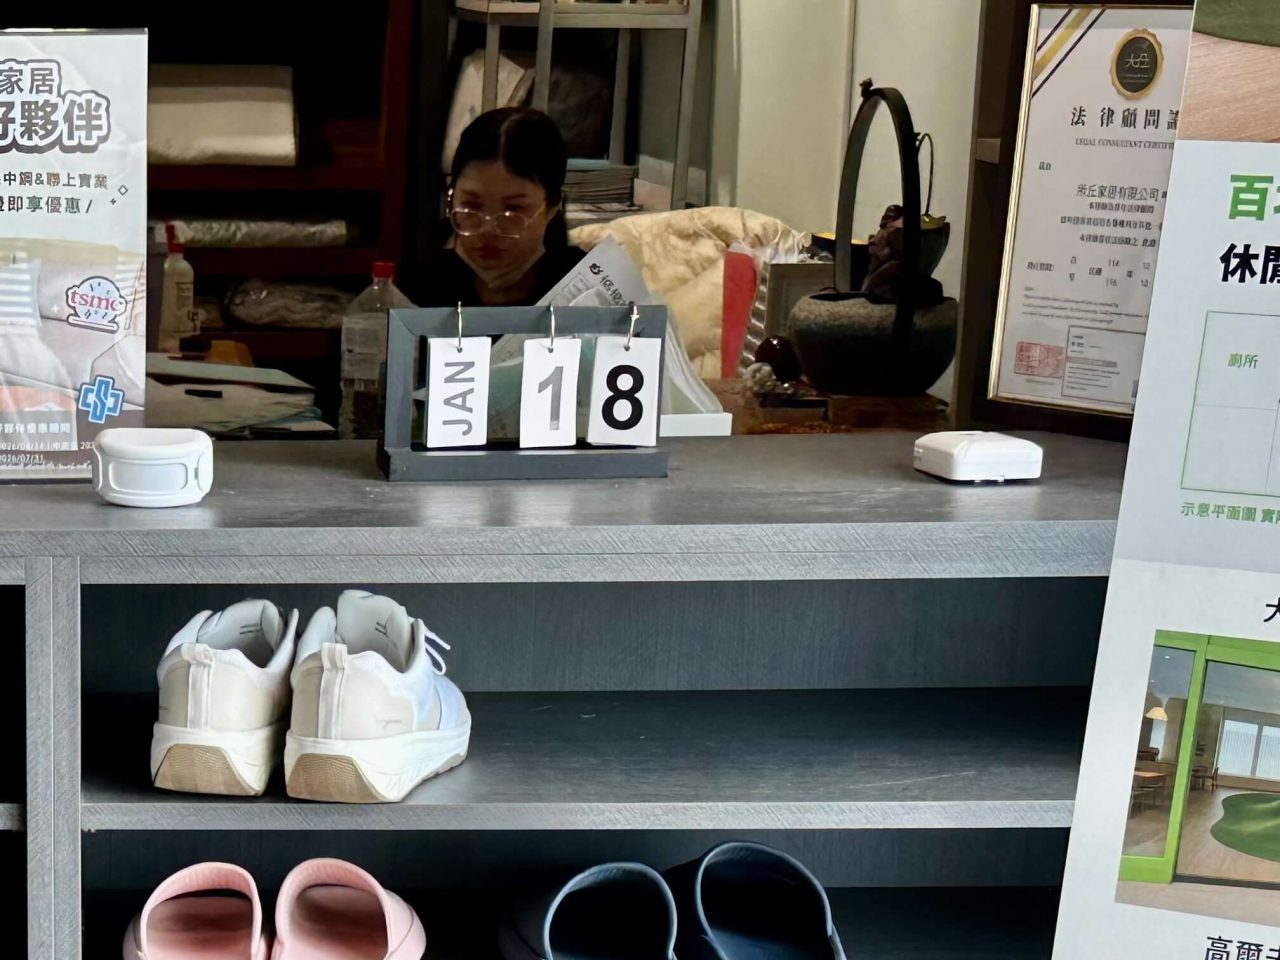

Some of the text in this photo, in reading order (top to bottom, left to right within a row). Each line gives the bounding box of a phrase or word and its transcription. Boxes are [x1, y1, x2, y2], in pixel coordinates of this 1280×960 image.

[1228, 174, 1280, 221] 百
[70, 289, 120, 313] tsmc
[442, 360, 645, 436] JAN 1 8
[1180, 501, 1280, 524] 示意平面圖 實
